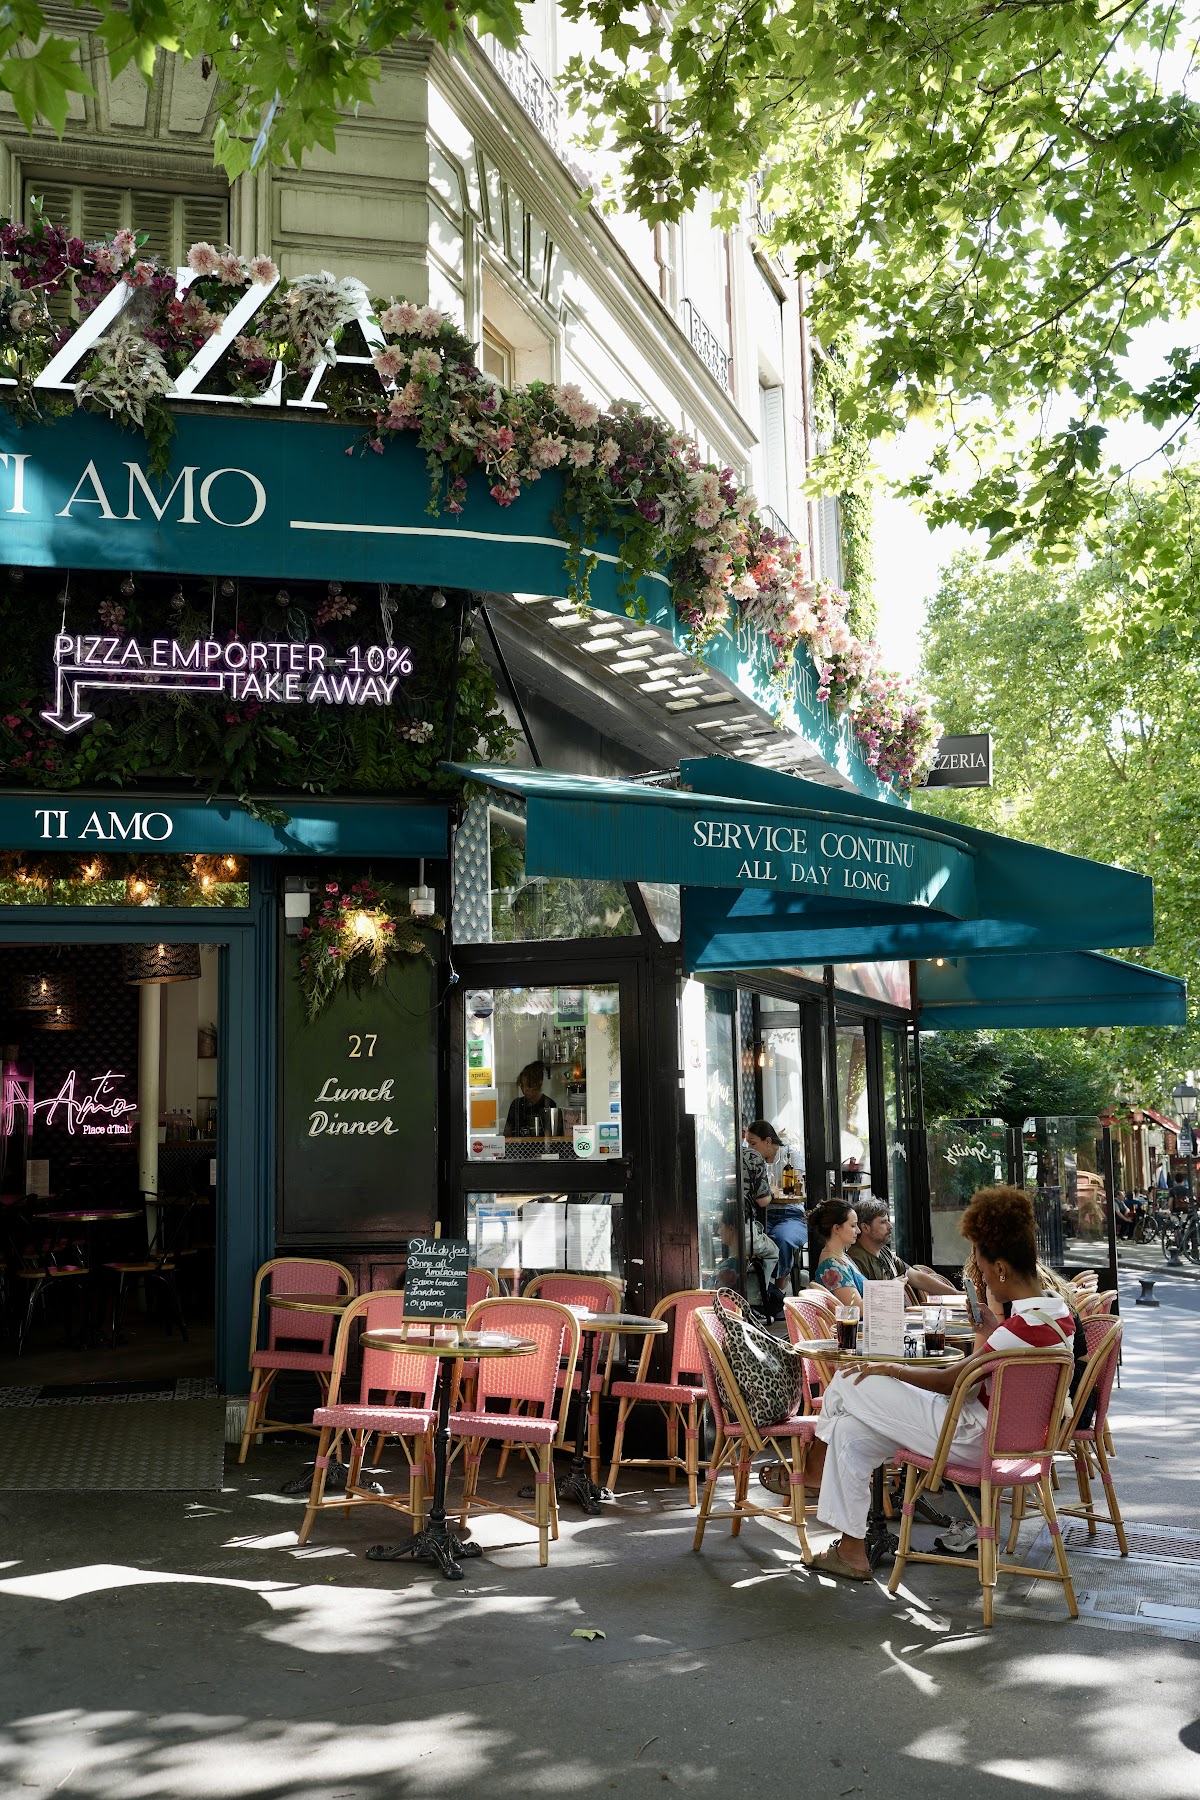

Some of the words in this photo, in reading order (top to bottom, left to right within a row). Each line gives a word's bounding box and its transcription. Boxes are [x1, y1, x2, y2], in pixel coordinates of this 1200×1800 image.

[0, 453, 33, 515] I
[54, 458, 267, 528] AMO
[55, 634, 144, 667] PIZZA
[152, 639, 326, 671] EMPORTER
[334, 645, 413, 675] -10%
[224, 672, 301, 700] TAKE
[309, 675, 399, 704] AWAY
[34, 809, 70, 839] TI
[77, 810, 174, 841] AMO
[693, 820, 808, 855] SERVICE
[820, 832, 915, 868] CONTINU
[736, 859, 777, 881] ALL
[790, 862, 832, 886] DAY
[843, 868, 891, 892] LONG
[348, 1033, 378, 1058] 27
[33, 1069, 137, 1135] Amo
[314, 1077, 395, 1103] Lunch
[82, 1124, 105, 1135] Place
[106, 1123, 132, 1135] d'Ital
[308, 1110, 399, 1136] Dinner
[409, 1238, 437, 1255] Plat
[438, 1245, 449, 1255] du
[407, 1256, 434, 1270] Penne
[435, 1278, 459, 1287] tomate
